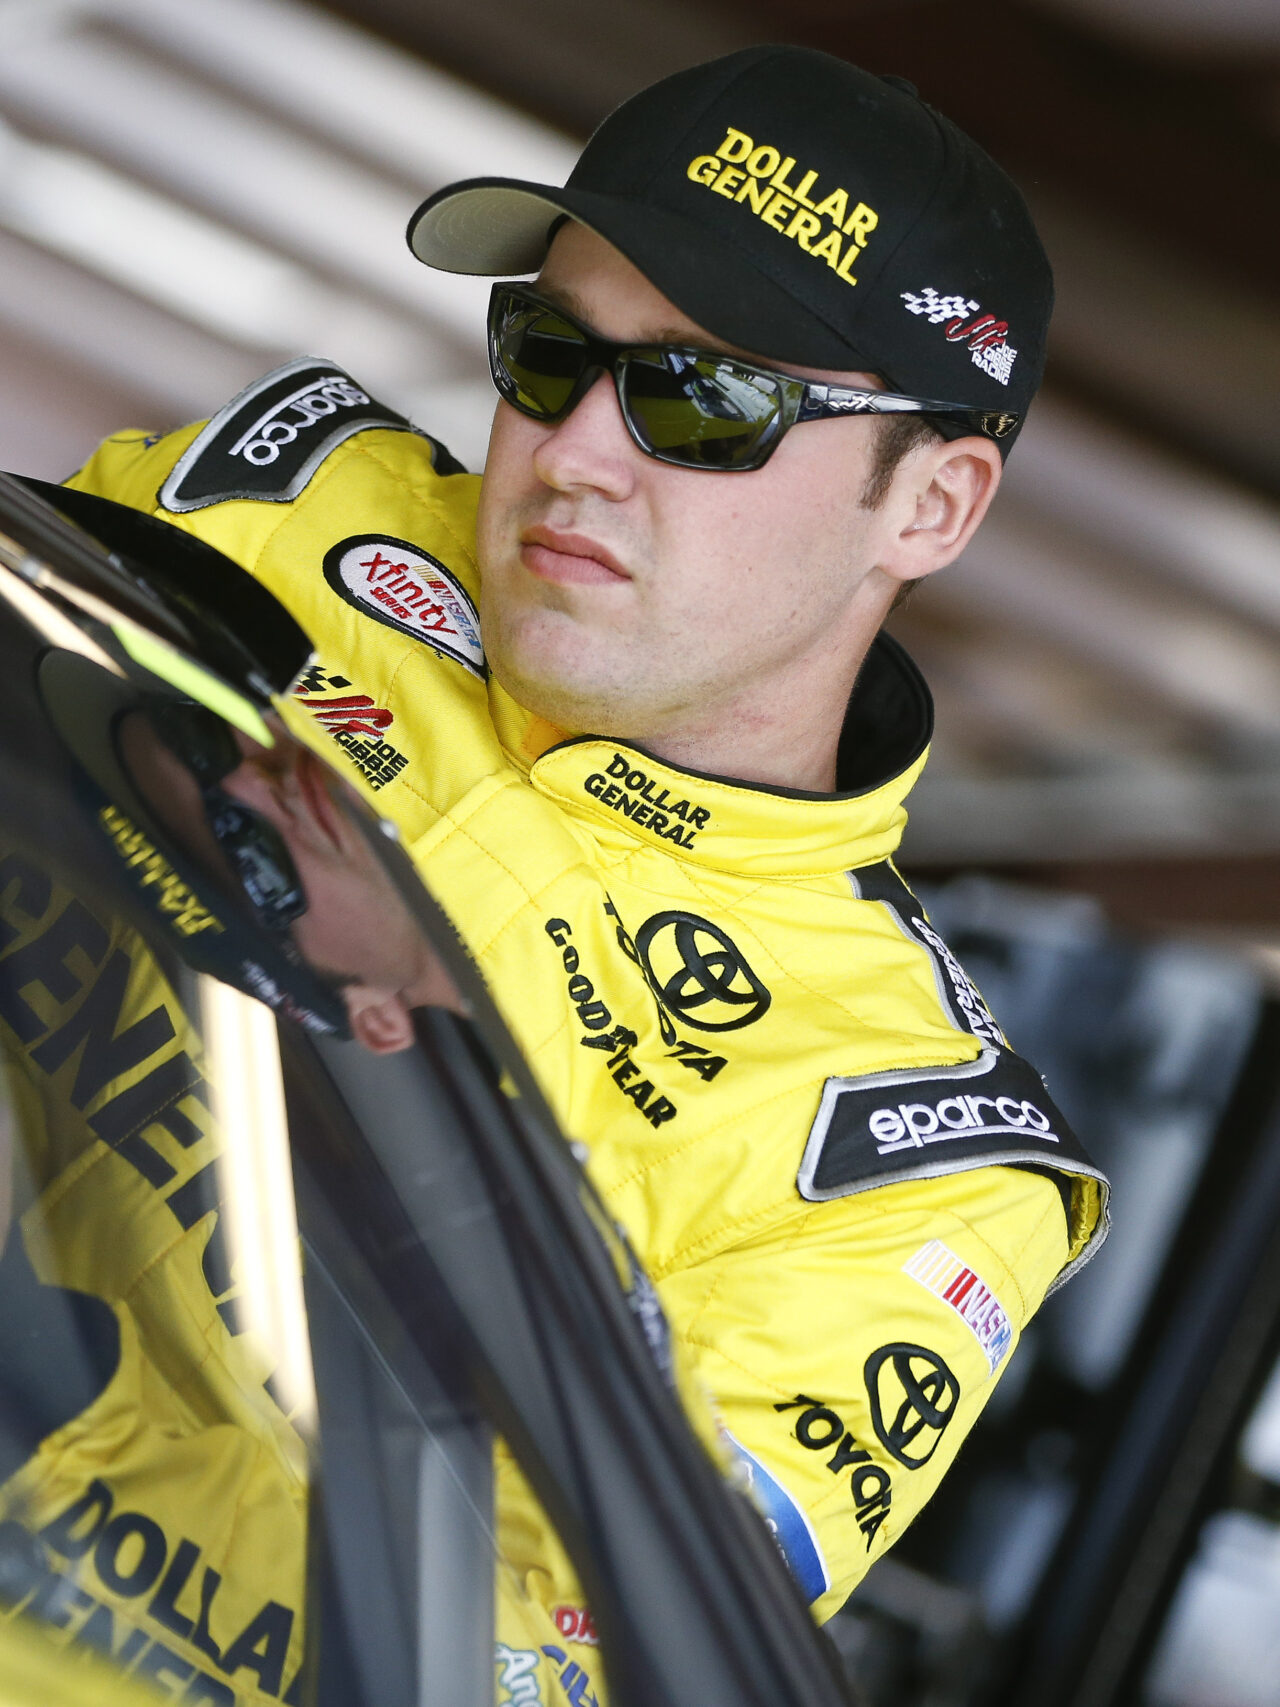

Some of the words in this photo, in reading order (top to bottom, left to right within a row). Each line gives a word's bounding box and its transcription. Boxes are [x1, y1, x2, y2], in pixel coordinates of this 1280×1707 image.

[687, 155, 858, 287] GENERAL
[715, 127, 878, 248] DOLLAR
[233, 377, 370, 466] sparco
[334, 731, 399, 784] GIBBS
[363, 739, 409, 772] JOE
[606, 753, 711, 830] DOLLAR
[584, 773, 695, 850] GENERAL
[545, 917, 677, 1129] GOODYEAR
[869, 1094, 1051, 1150] sparco
[37, 1477, 308, 1707] DOLLA
